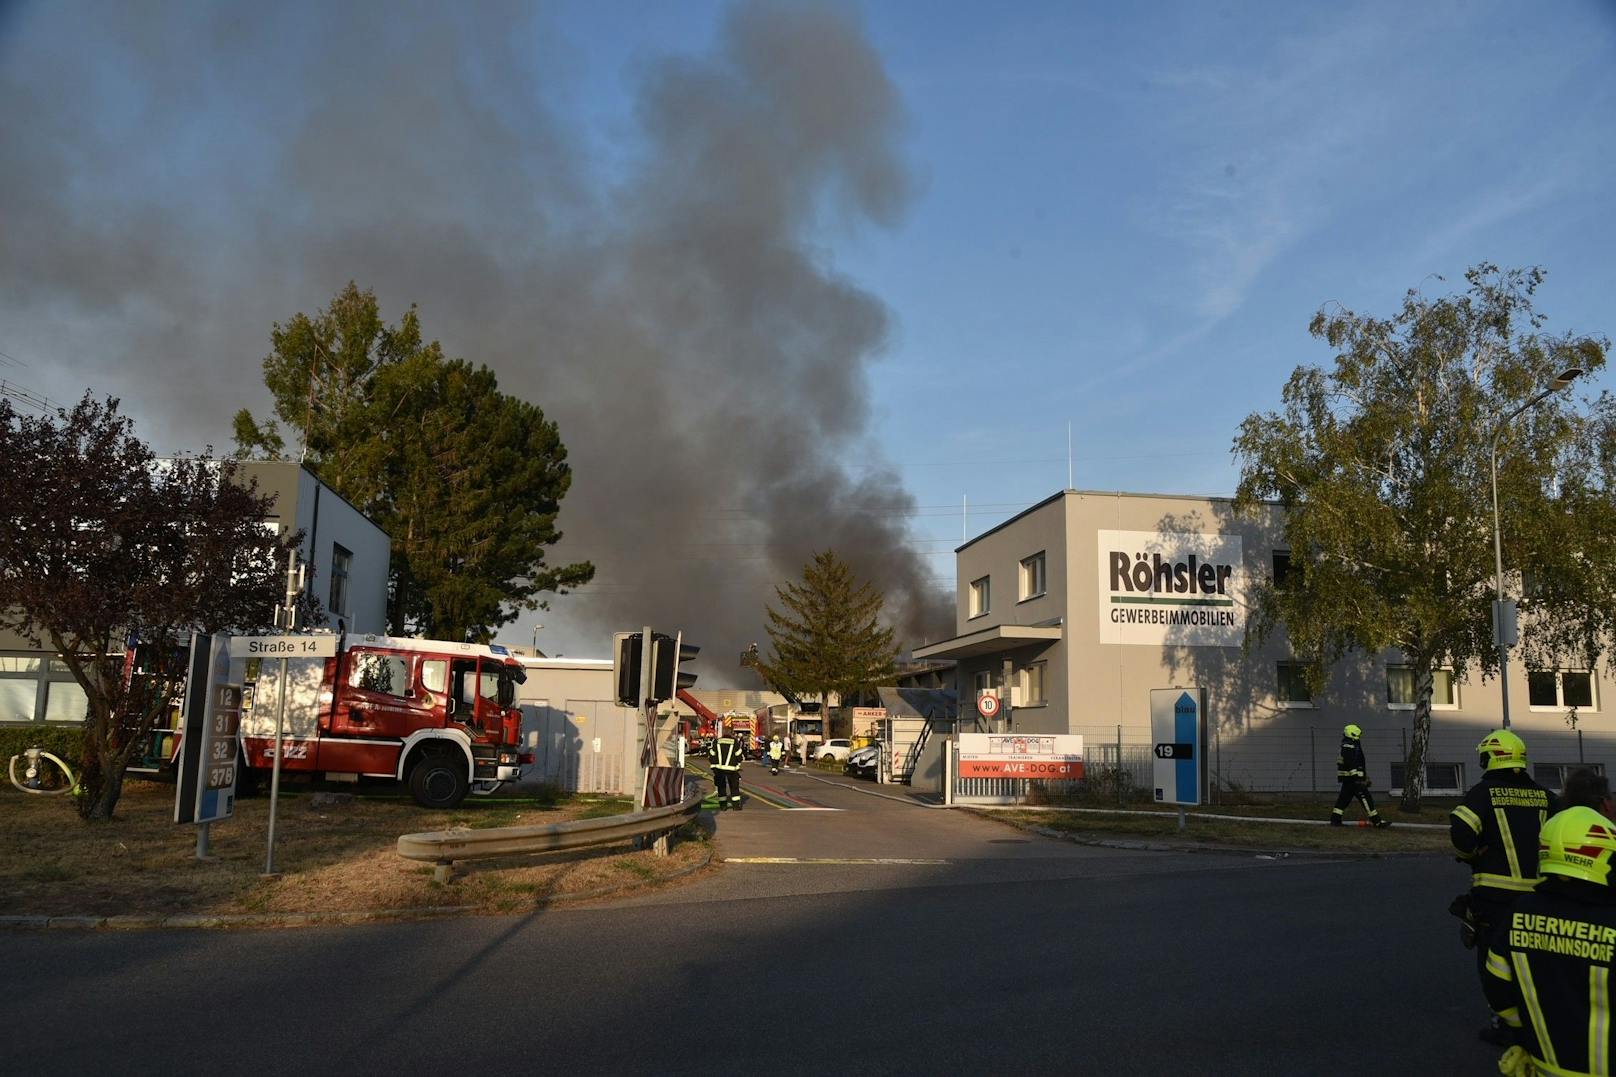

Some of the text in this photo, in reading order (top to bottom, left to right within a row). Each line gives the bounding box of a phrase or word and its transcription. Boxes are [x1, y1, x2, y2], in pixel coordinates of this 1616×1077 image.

[1109, 551, 1232, 595] Röhsler
[1110, 608, 1234, 626] GEWERBEIMMOBILIEN
[249, 641, 317, 653] Straße 14
[220, 688, 233, 706] 12
[984, 700, 993, 710] 10
[215, 714, 229, 732] 31
[213, 741, 228, 760] 32
[1158, 745, 1174, 757] 19
[972, 763, 1071, 773] www.AVE-DOG.at
[1489, 787, 1548, 799] FEUERWEHR
[1564, 853, 1594, 868] WEHR
[1512, 912, 1616, 945] EUERWEHR
[1509, 929, 1614, 962] IEDERMANNSDORF
